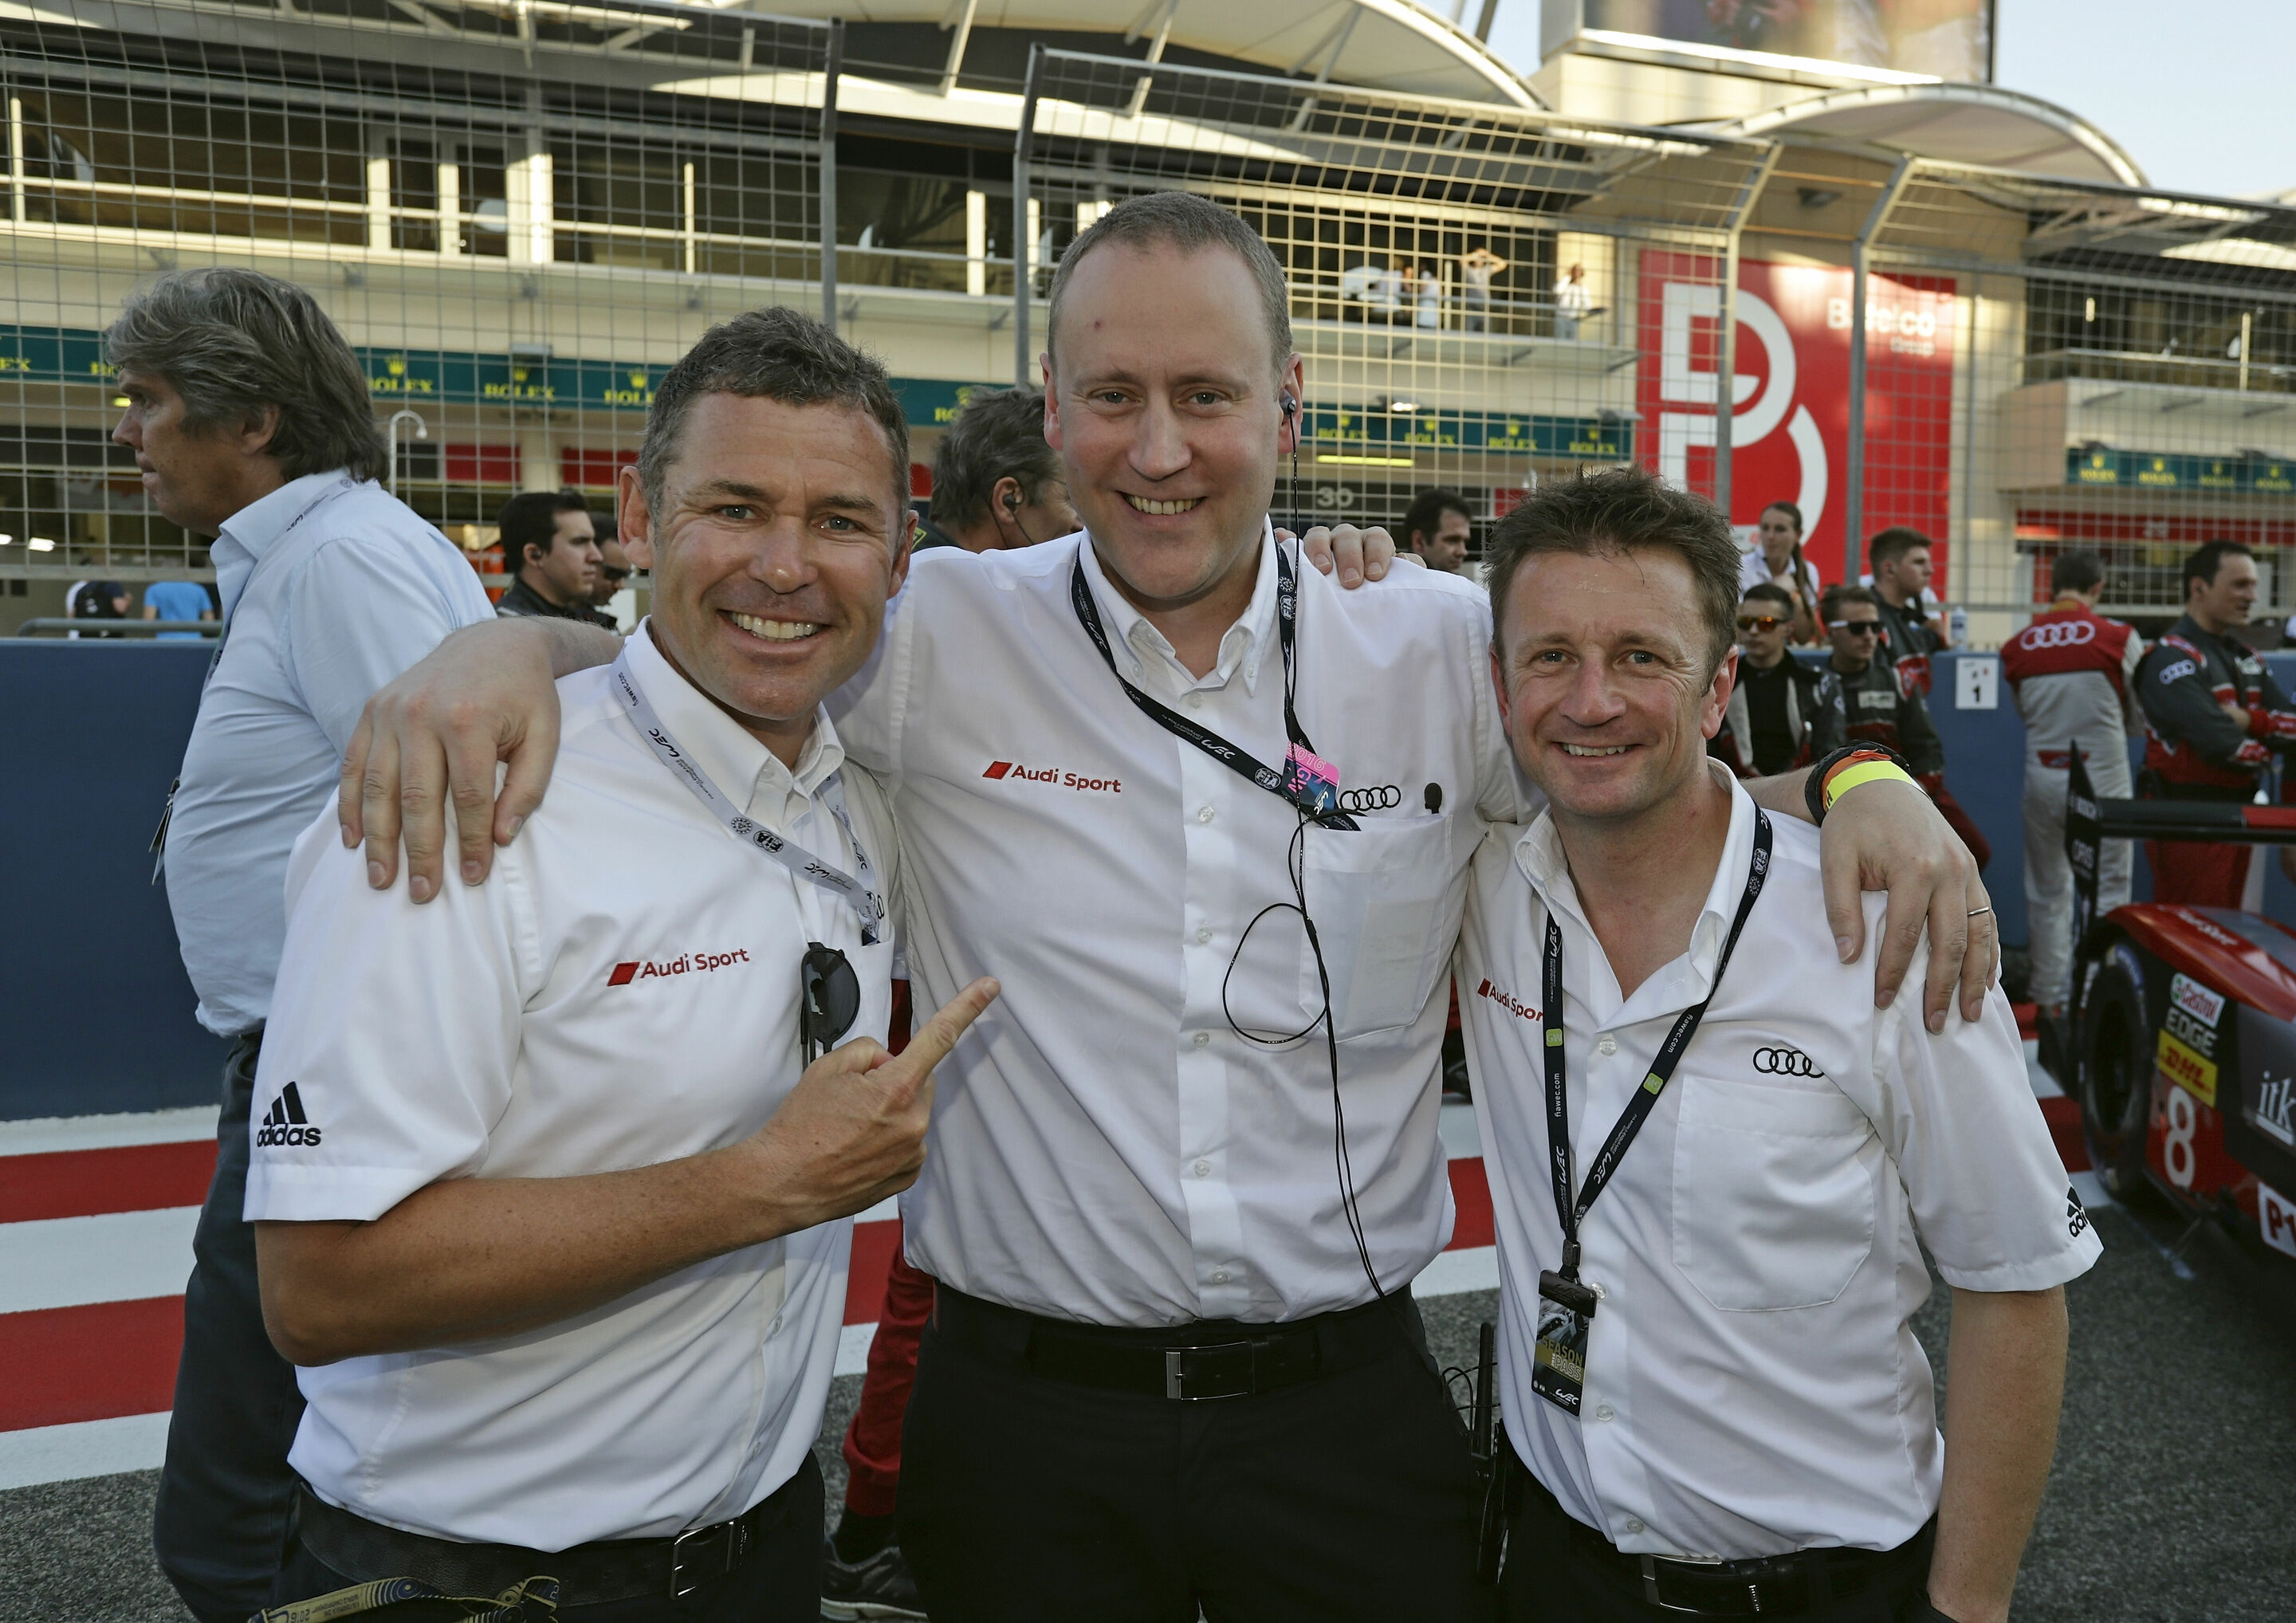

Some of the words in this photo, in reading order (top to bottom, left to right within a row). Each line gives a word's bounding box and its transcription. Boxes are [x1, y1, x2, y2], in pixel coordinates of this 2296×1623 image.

[1827, 297, 1936, 336] Btelco
[485, 383, 556, 402] ROLEX
[1317, 427, 1370, 441] ROLEX
[1405, 432, 1456, 446] ROLEX
[1488, 436, 1538, 450] ROLEX
[1569, 442, 1618, 454] ROLEX
[1317, 486, 1354, 508] 30
[648, 728, 681, 757] WEC
[1201, 739, 1236, 760] WEC
[1011, 764, 1060, 784] Audi
[1063, 772, 1122, 793] Sport
[1256, 768, 1280, 788] FIA
[756, 831, 784, 852] FIA
[640, 953, 690, 979] Audi
[696, 948, 750, 971] Sport
[1489, 984, 1510, 1008] Audi
[1511, 997, 1544, 1021] Spor
[1667, 1013, 1693, 1054] fiawec.com
[2165, 1005, 2218, 1058] EDGE
[2164, 1045, 2205, 1091] DHL
[257, 1122, 321, 1147] adidas
[2164, 1085, 2196, 1189] 8
[1556, 1146, 1567, 1185] WEC
[1594, 1152, 1612, 1185] WEC
[1543, 1334, 1583, 1366] SEASON
[1555, 1354, 1582, 1381] PASS
[1555, 1389, 1579, 1405] WEC
